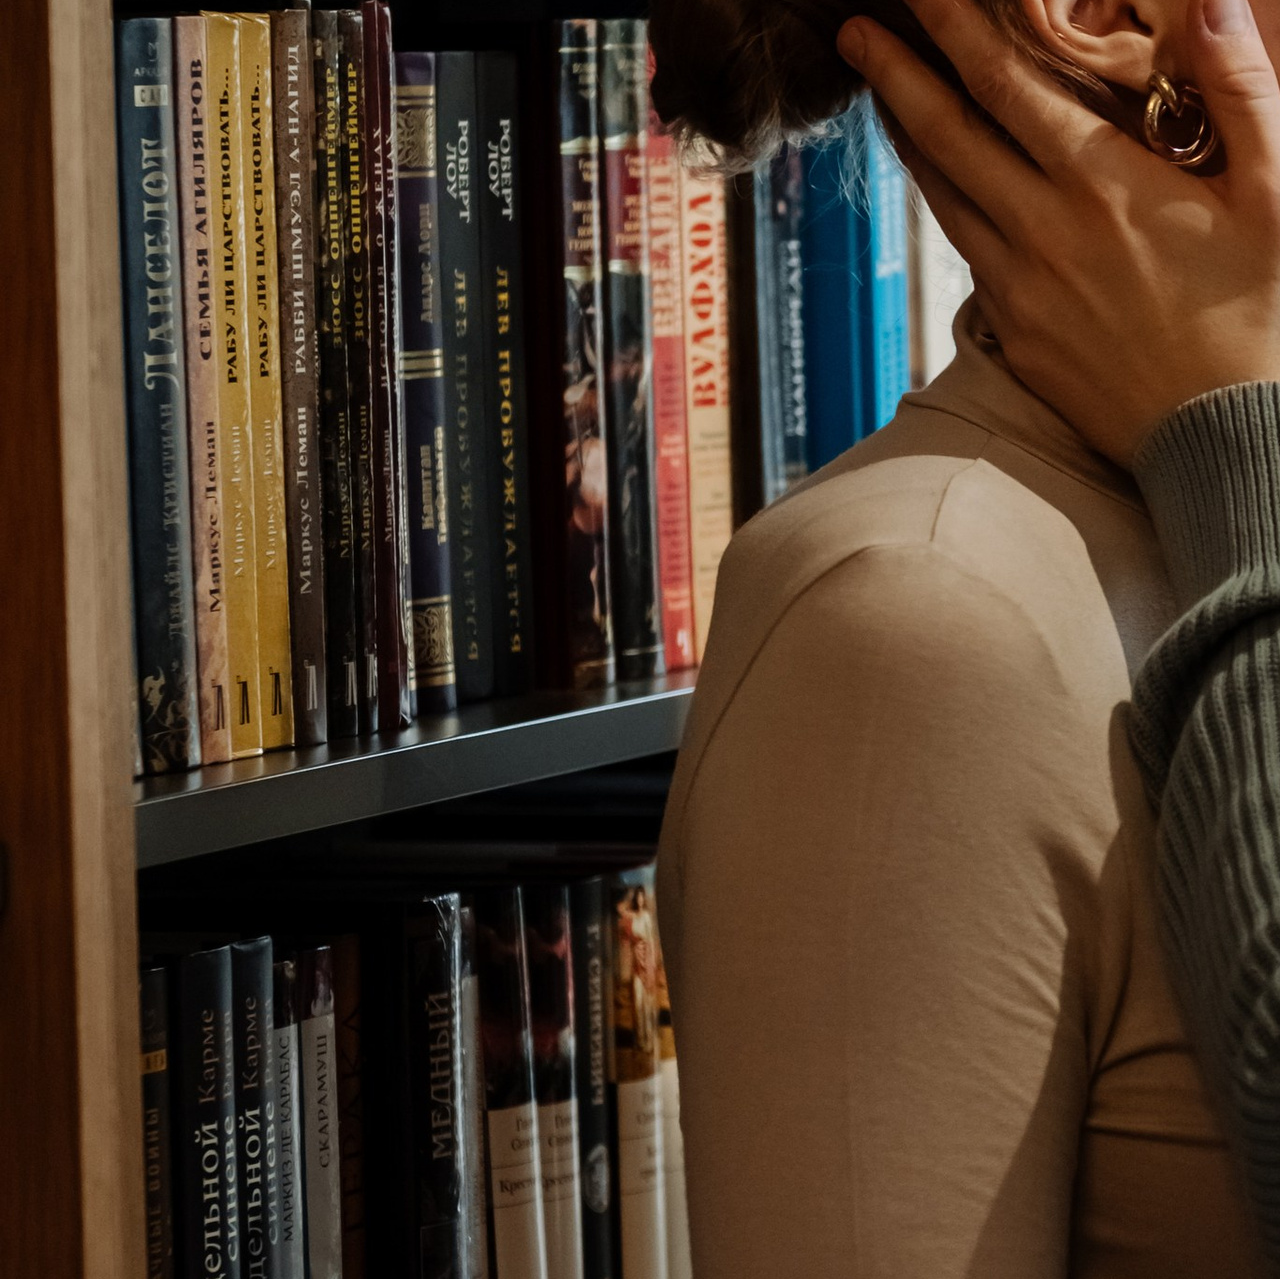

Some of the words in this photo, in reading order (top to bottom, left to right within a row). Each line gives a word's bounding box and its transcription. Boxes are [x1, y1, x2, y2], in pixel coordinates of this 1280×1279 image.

[190, 58, 208, 236] АГИЛЯРОВ
[284, 44, 301, 164] А-НАГИД
[219, 67, 236, 272] ЦАРСТВОВАТЬ...
[252, 63, 267, 267] ЦАРСТВОВАТЬ...
[324, 66, 341, 261] ОППЕНГЕЙМЕР
[346, 61, 363, 254] ОППЕНГЕЙМЕР
[372, 125, 382, 216] ЖЕНАХ
[445, 141, 458, 200] ЛОУ
[457, 119, 470, 224] РОБЕРТ
[486, 140, 501, 198] ЛОУ
[498, 117, 514, 222] РОБЕРТ
[289, 171, 305, 280] ШМУЭЛ
[196, 248, 213, 361] СЕМЬЯ
[224, 278, 236, 316] ЛИ
[256, 274, 267, 306] ЛИ
[293, 284, 306, 373] РАББИ
[330, 272, 344, 348] ЗЮСС
[352, 266, 365, 343] ЗЮСС
[374, 265, 388, 389] ИСТОРИЯ
[452, 267, 468, 339] ЛЕВ
[494, 265, 511, 336] ЛЕВ
[225, 322, 239, 384] РАБУ
[258, 315, 271, 378] РАБУ
[204, 421, 218, 505] Леман
[228, 425, 243, 493] Леман
[260, 419, 275, 484] Леман
[294, 406, 310, 490] Леман
[335, 410, 348, 476] Леман
[357, 404, 369, 469] Леман
[231, 499, 246, 578] Маркус
[262, 492, 278, 570] Маркус
[338, 483, 351, 559] Маркус
[359, 475, 371, 550] Маркус
[382, 482, 394, 542] Маркус
[496, 348, 523, 655] ПРОБУЖДАЕТСЯ
[208, 514, 221, 612] Маркус
[297, 497, 313, 595] Маркус
[196, 1008, 220, 1104] Карме
[239, 994, 262, 1090] Карме
[276, 1034, 291, 1124] КАРАБАС
[424, 992, 451, 1161] МЕДНЫЙ
[278, 1127, 292, 1155] ДЕ
[316, 1034, 331, 1169] СКАРАМУШ
[221, 1113, 239, 1262] синеве
[262, 1096, 279, 1245] синеве
[279, 1159, 295, 1242] МАРКИЗ
